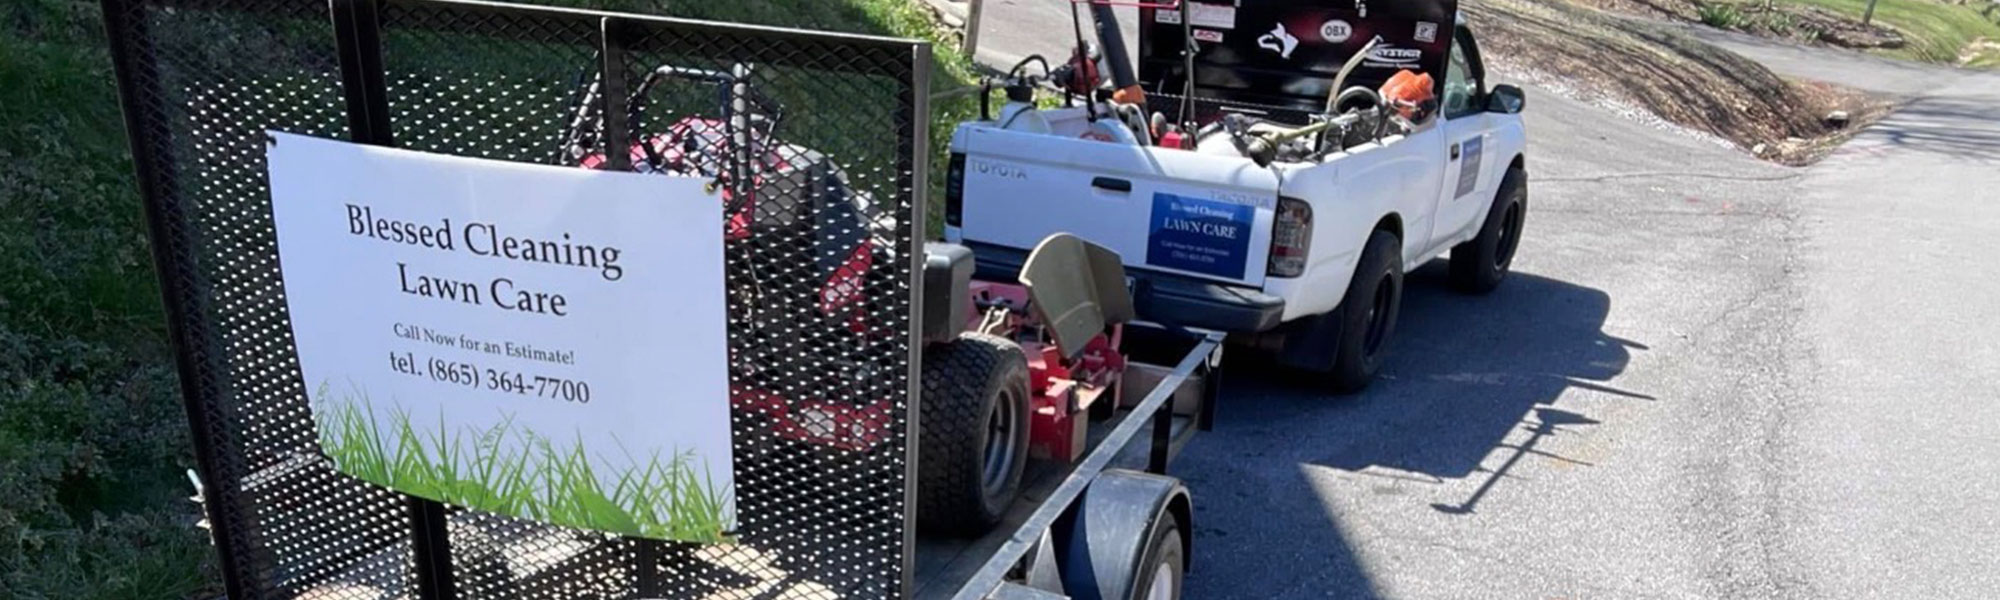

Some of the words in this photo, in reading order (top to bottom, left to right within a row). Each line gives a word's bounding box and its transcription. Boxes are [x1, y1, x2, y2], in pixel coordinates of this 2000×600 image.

[1325, 25, 1347, 37] OBX
[970, 159, 1029, 181] TOYOTA
[345, 203, 456, 252] Blessed
[463, 222, 623, 282] Cleaning
[1163, 216, 1201, 233] LAWN
[1202, 222, 1238, 239] CARE
[396, 262, 482, 306] Lawn
[489, 277, 567, 317] Care
[393, 322, 421, 342] Call
[423, 327, 456, 347] Now
[459, 334, 480, 351] for
[483, 342, 501, 355] an
[504, 341, 575, 366] Estimate!
[389, 351, 423, 377] tel.
[427, 356, 480, 389] (865)
[486, 368, 590, 404] 364-7700
